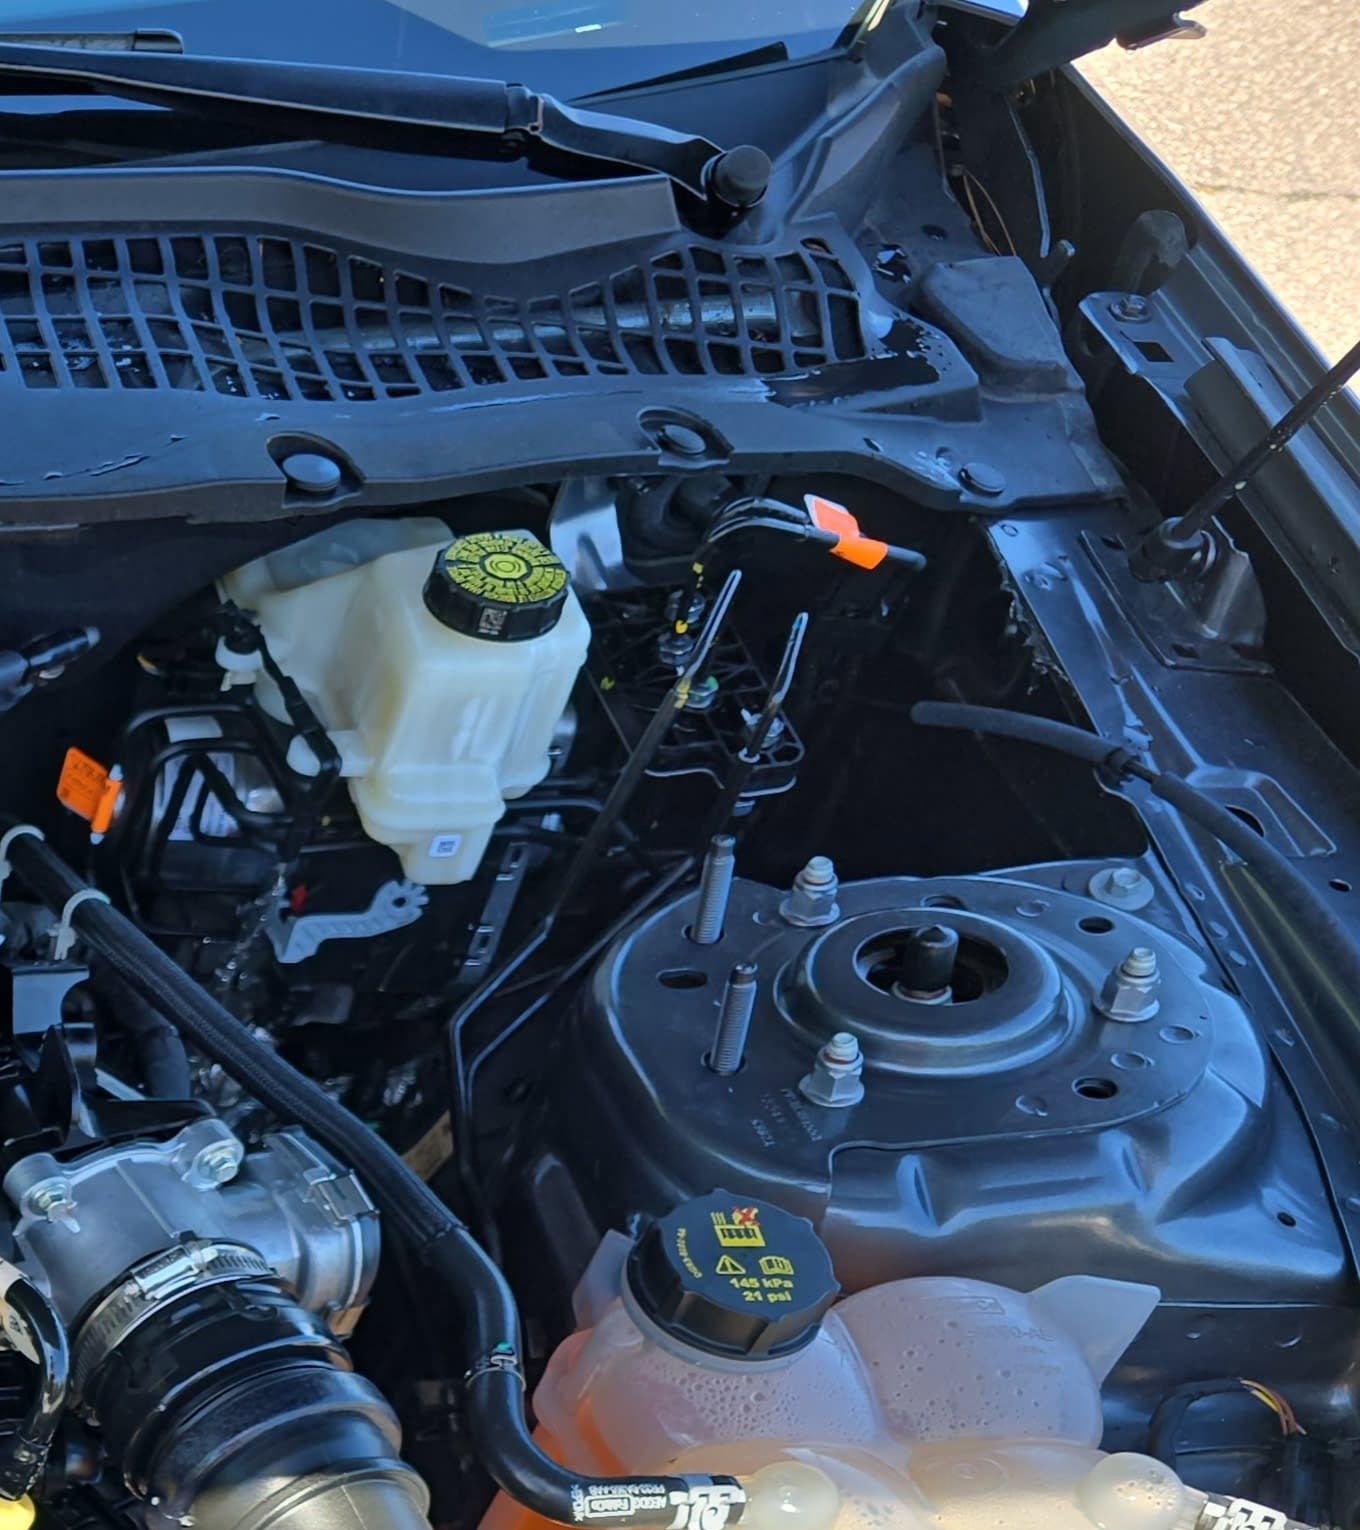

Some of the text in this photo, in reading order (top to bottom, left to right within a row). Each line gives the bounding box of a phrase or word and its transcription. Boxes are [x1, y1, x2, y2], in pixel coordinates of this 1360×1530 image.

[730, 1277, 794, 1289] 145 kPa
[742, 1290, 792, 1304] 21 psi
